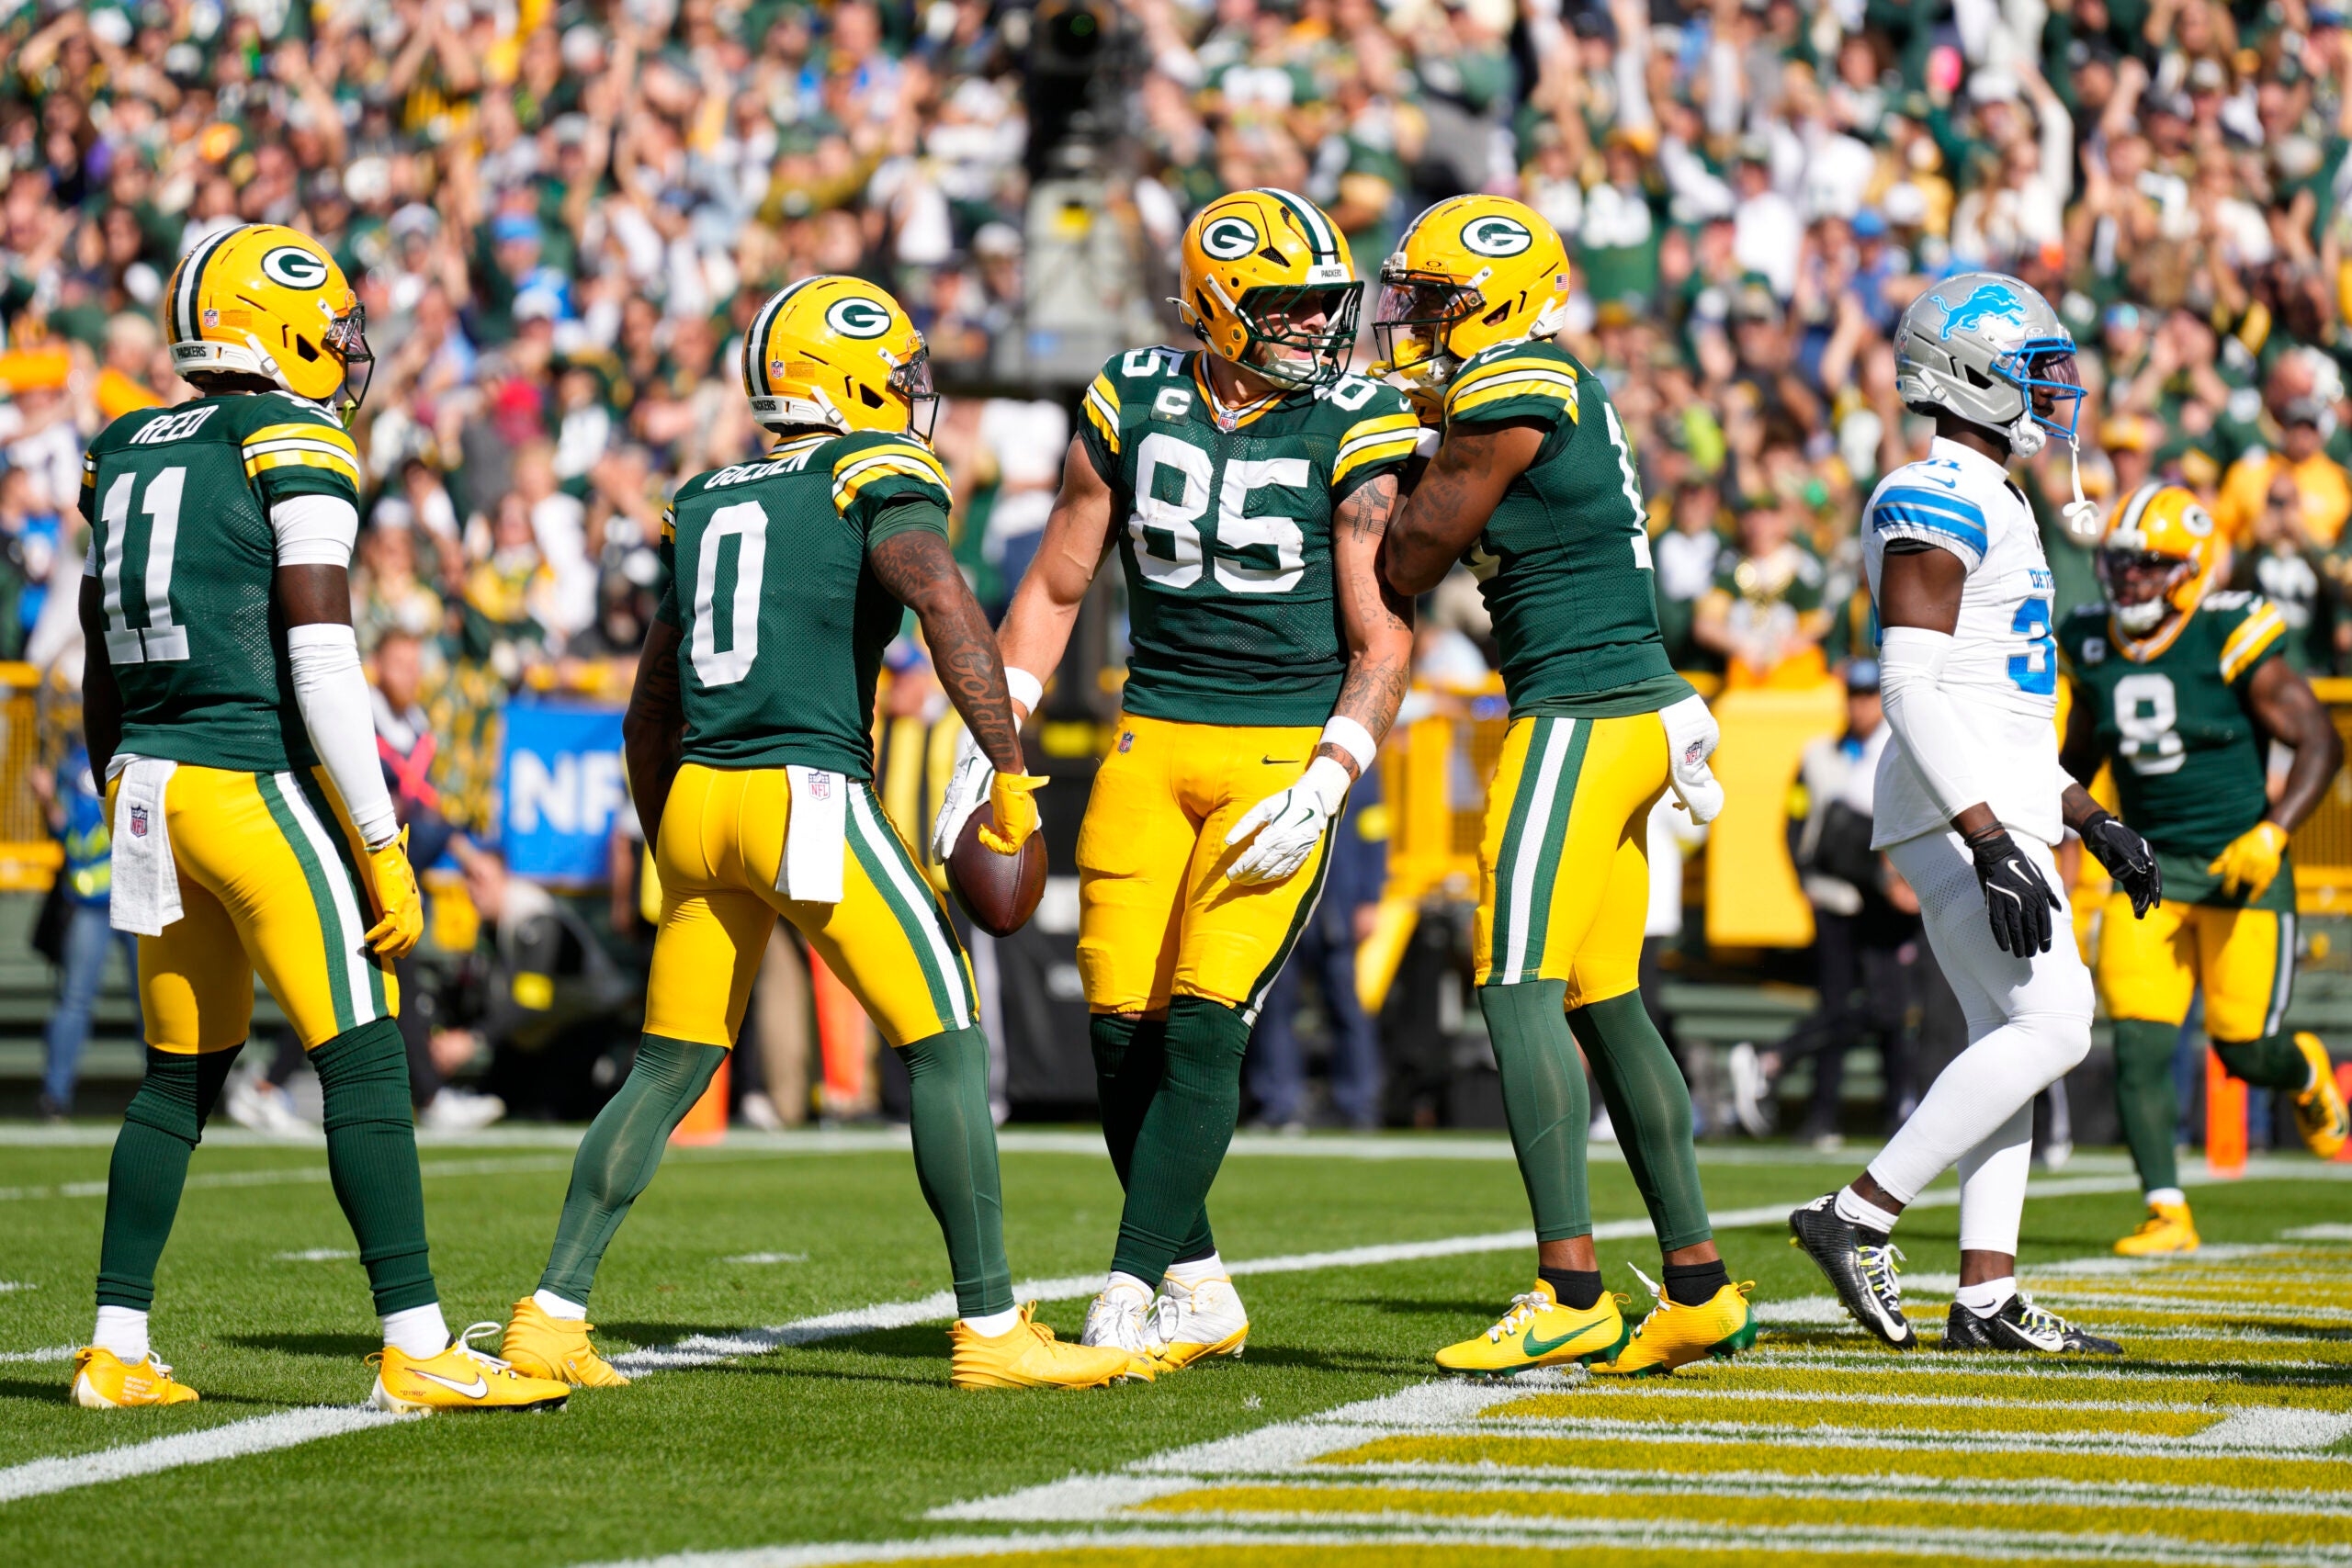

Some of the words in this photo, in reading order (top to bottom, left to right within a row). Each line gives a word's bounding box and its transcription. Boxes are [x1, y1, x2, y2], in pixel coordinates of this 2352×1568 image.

[1202, 218, 1257, 258] G
[1462, 217, 1532, 256] G
[263, 247, 328, 288] G
[1321, 269, 1342, 277] PACKERS
[828, 299, 889, 337] G
[175, 345, 207, 359] PACKERS
[1156, 389, 1191, 415] C
[129, 405, 219, 445] REED
[1128, 432, 1311, 592] 85
[101, 467, 190, 664] 11
[691, 500, 768, 688] 0
[2114, 675, 2187, 775] 8
[511, 748, 625, 835] NF
[811, 784, 828, 797] NFL
